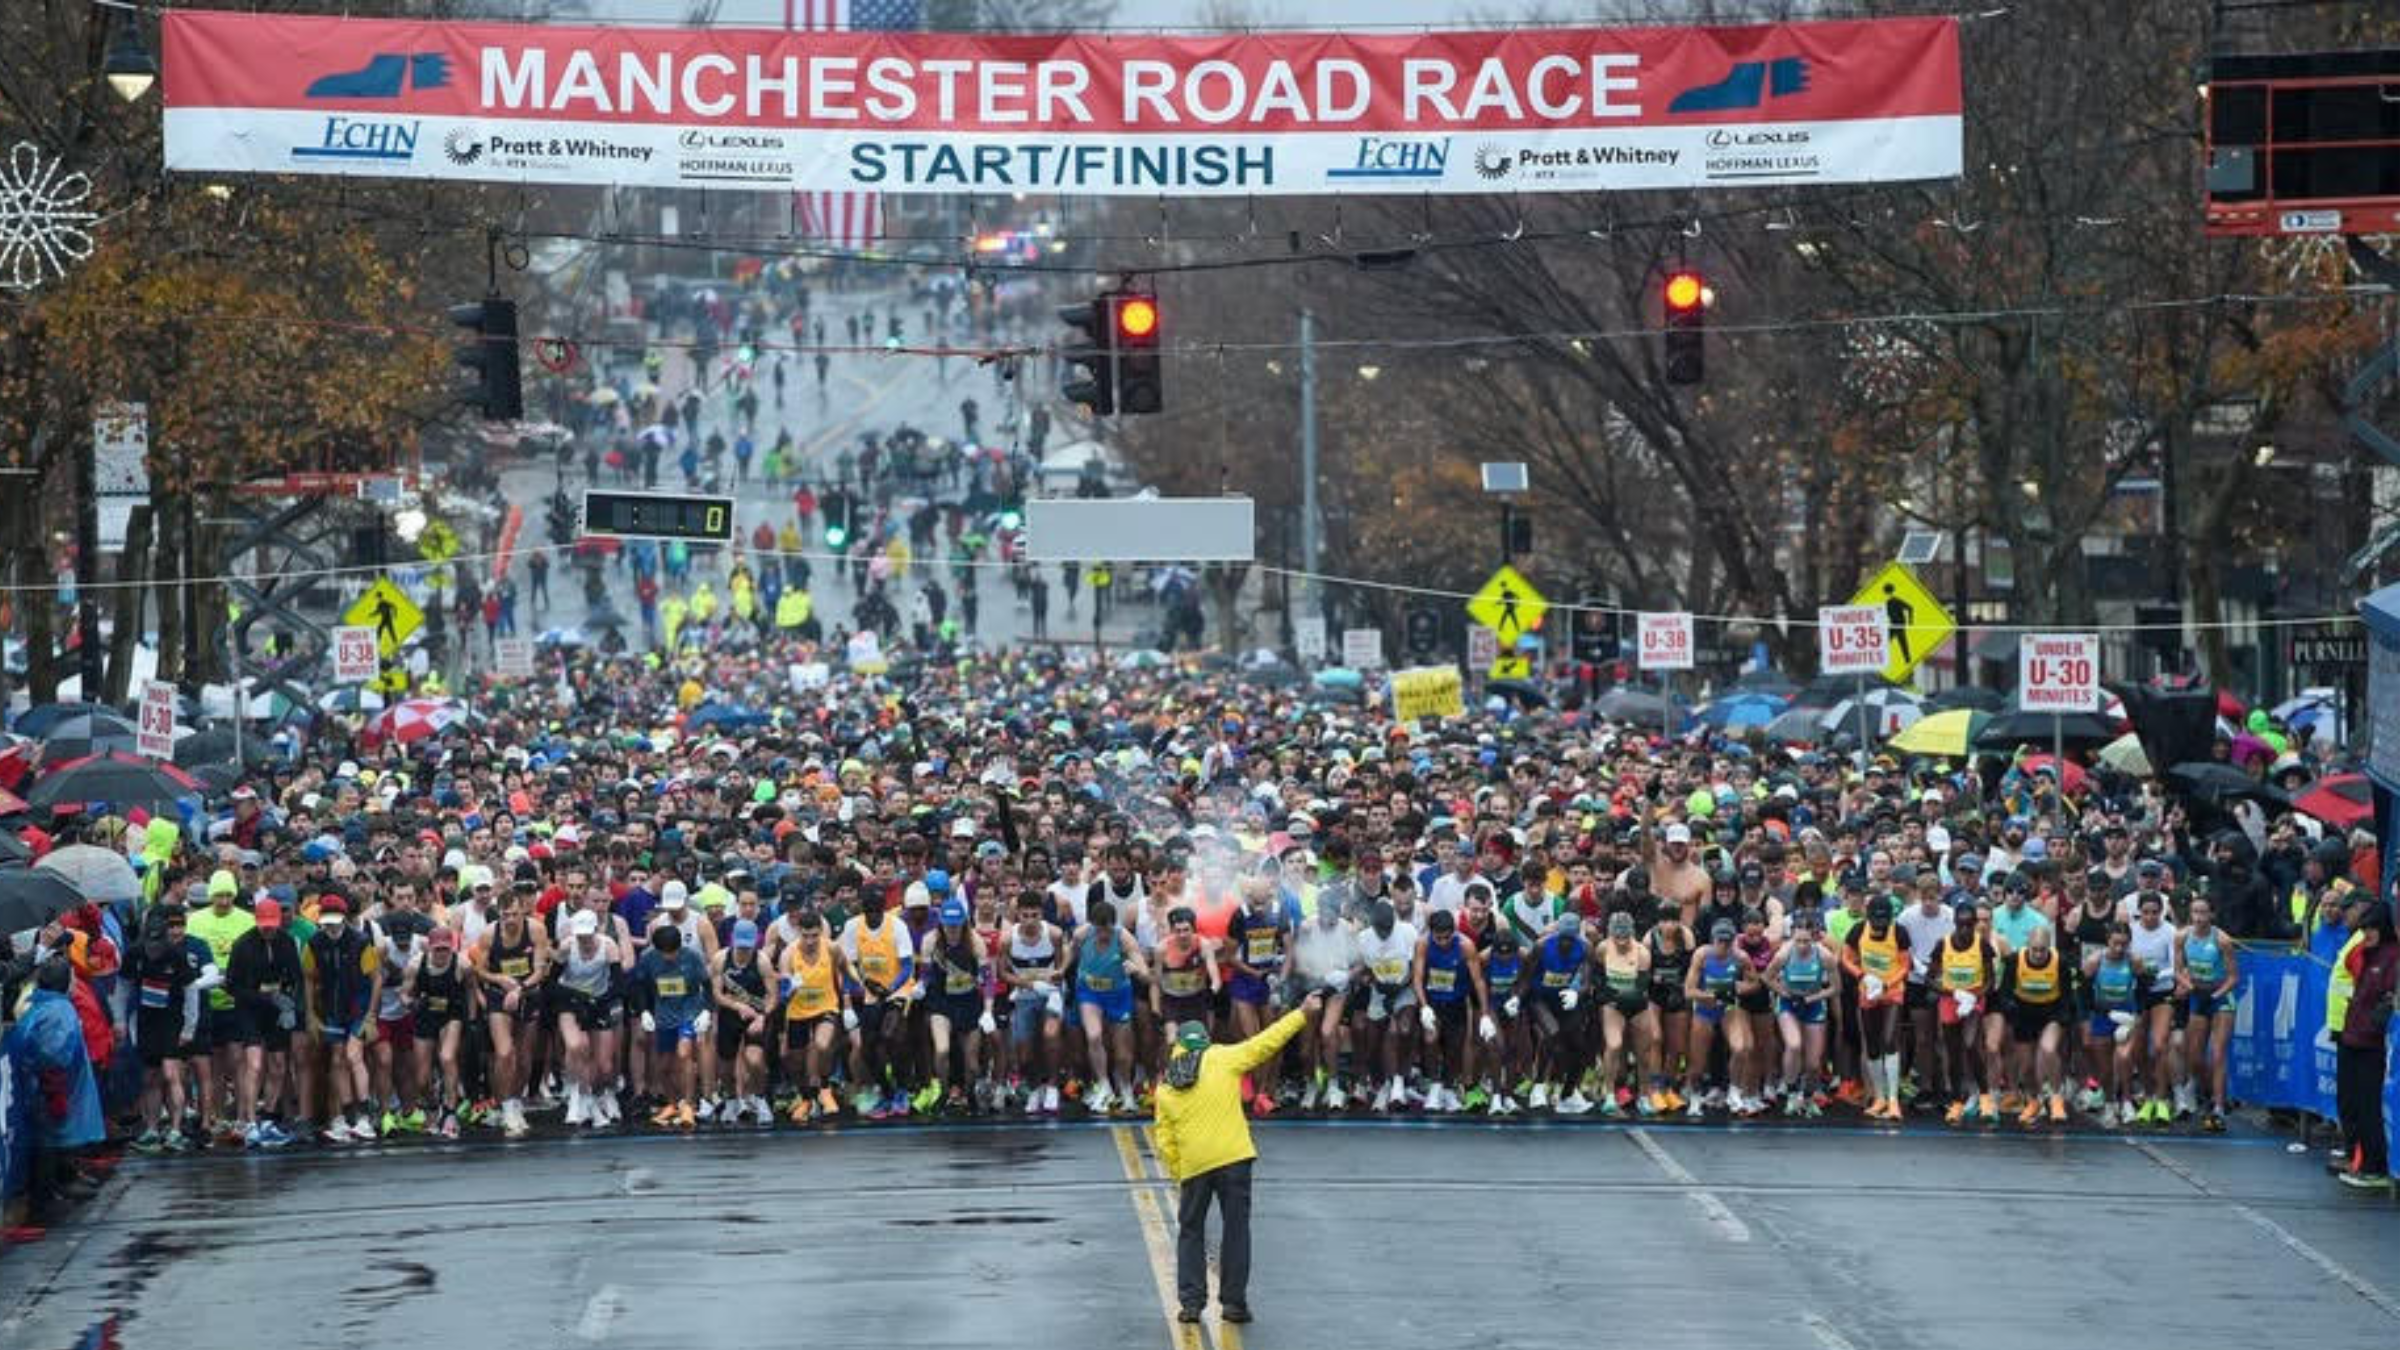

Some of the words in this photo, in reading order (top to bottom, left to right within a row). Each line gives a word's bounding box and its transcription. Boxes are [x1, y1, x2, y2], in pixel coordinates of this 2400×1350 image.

[480, 47, 1095, 124] MANCHESTER
[1122, 58, 1371, 124] ROAD
[1403, 53, 1643, 121] RACE
[323, 116, 421, 152] ECHN
[709, 135, 784, 149] LEXUS
[1734, 130, 1810, 145] LEXUS
[490, 136, 543, 156] Pratt
[549, 139, 562, 156] &
[565, 139, 654, 162] Whitney
[1357, 136, 1452, 170] ECHN
[1519, 149, 1570, 166] Pratt
[1576, 149, 1590, 165] &
[1593, 148, 1680, 165] Whitney
[680, 159, 747, 173] HOFFMAN
[750, 162, 794, 175] LEXUS
[850, 142, 1274, 188] START/FINISH
[1705, 157, 1773, 171] HOFFMAN
[1776, 156, 1820, 169] LEXUS
[704, 506, 725, 533] 0
[1831, 609, 1876, 624] UNDER
[1828, 625, 1882, 651] U-35
[2035, 640, 2084, 656] UNDER
[1828, 650, 1885, 668] MINUTES
[2029, 657, 2091, 686] U-30
[2027, 687, 2091, 704] MINUTES
